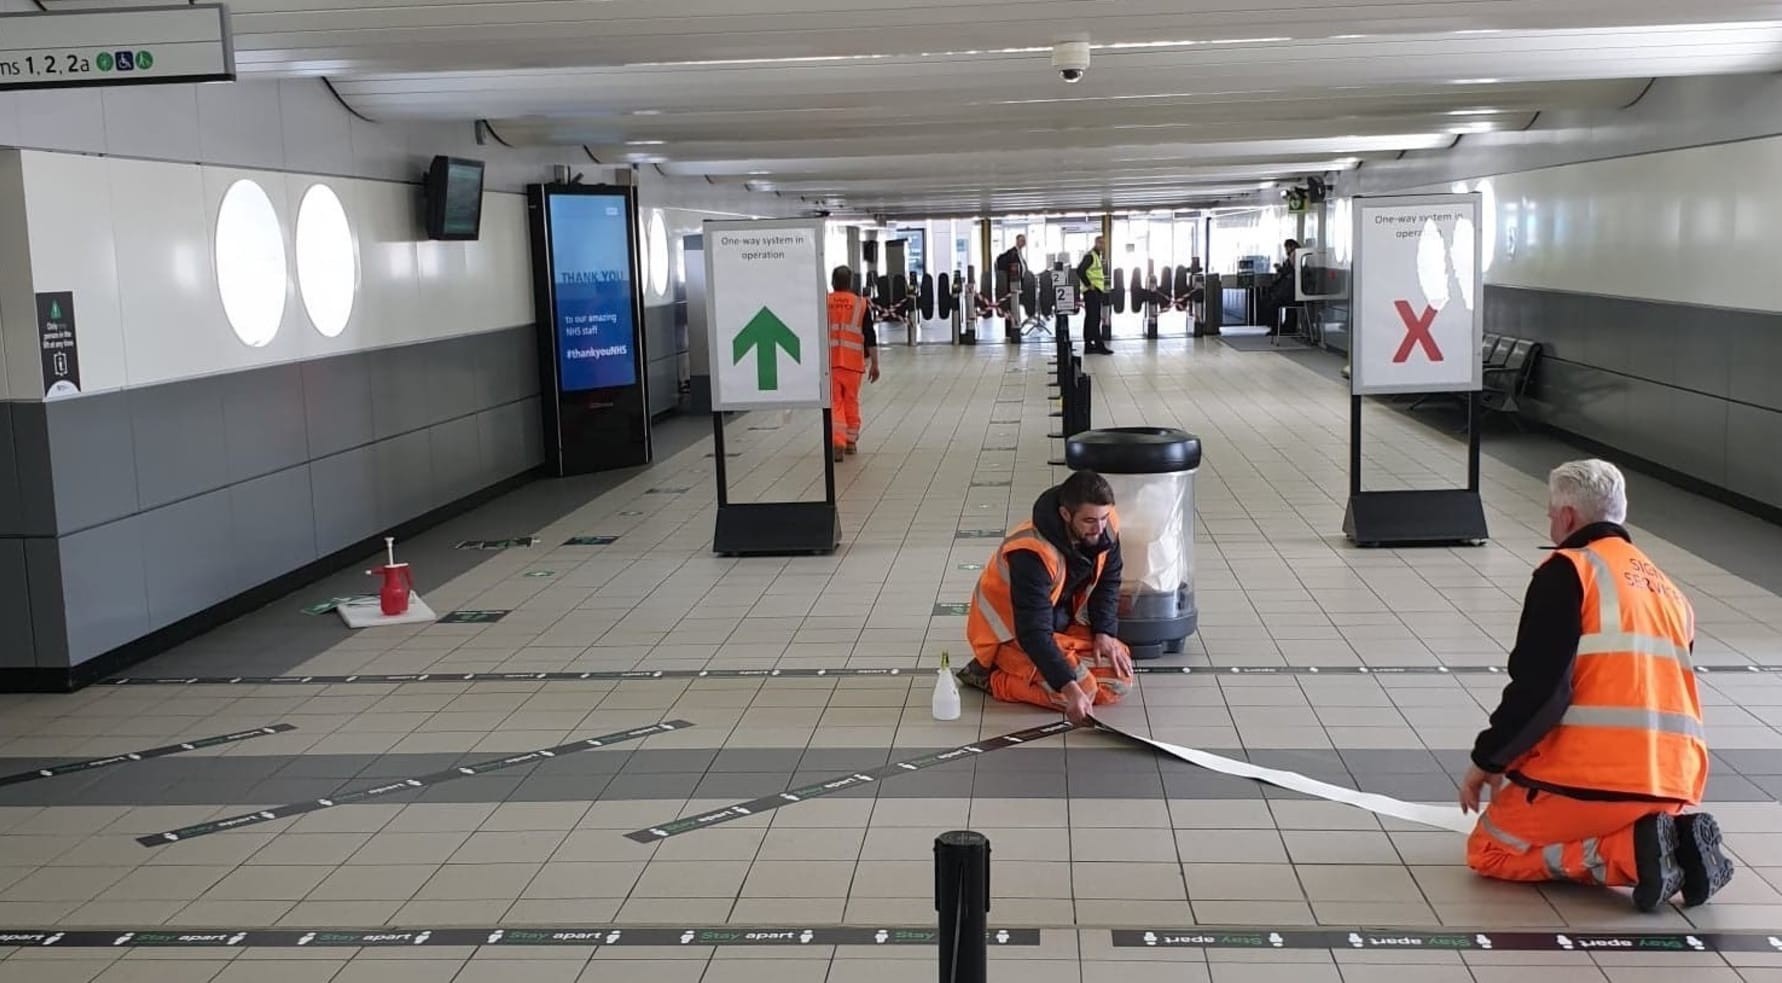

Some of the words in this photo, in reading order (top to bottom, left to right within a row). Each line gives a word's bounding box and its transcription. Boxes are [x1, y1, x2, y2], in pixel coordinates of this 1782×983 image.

[25, 56, 40, 75] 1,
[44, 55, 63, 75] 2,
[67, 54, 90, 72] 2a
[1375, 215, 1417, 224] One-way
[720, 236, 760, 247] One-way
[762, 235, 793, 247] system
[795, 235, 804, 245] in
[741, 251, 785, 261] operation
[562, 271, 598, 284] THANK
[601, 270, 623, 282] YOU
[1057, 288, 1065, 301] 2
[574, 315, 587, 324] our
[588, 313, 617, 324] amazing
[566, 326, 581, 336] NHS
[582, 325, 598, 336] staff
[567, 345, 627, 360] #thankyouNHS
[135, 933, 176, 943] Stay
[178, 933, 227, 942] apart
[319, 933, 362, 943] Stay
[363, 932, 412, 942] apart
[508, 931, 548, 941] Stay
[553, 931, 602, 941] apart
[701, 931, 741, 941] Stay
[745, 931, 795, 941] apart
[895, 931, 936, 941] Stay
[1163, 935, 1215, 945] apart
[1369, 936, 1422, 946] apart
[1578, 937, 1633, 948] apart
